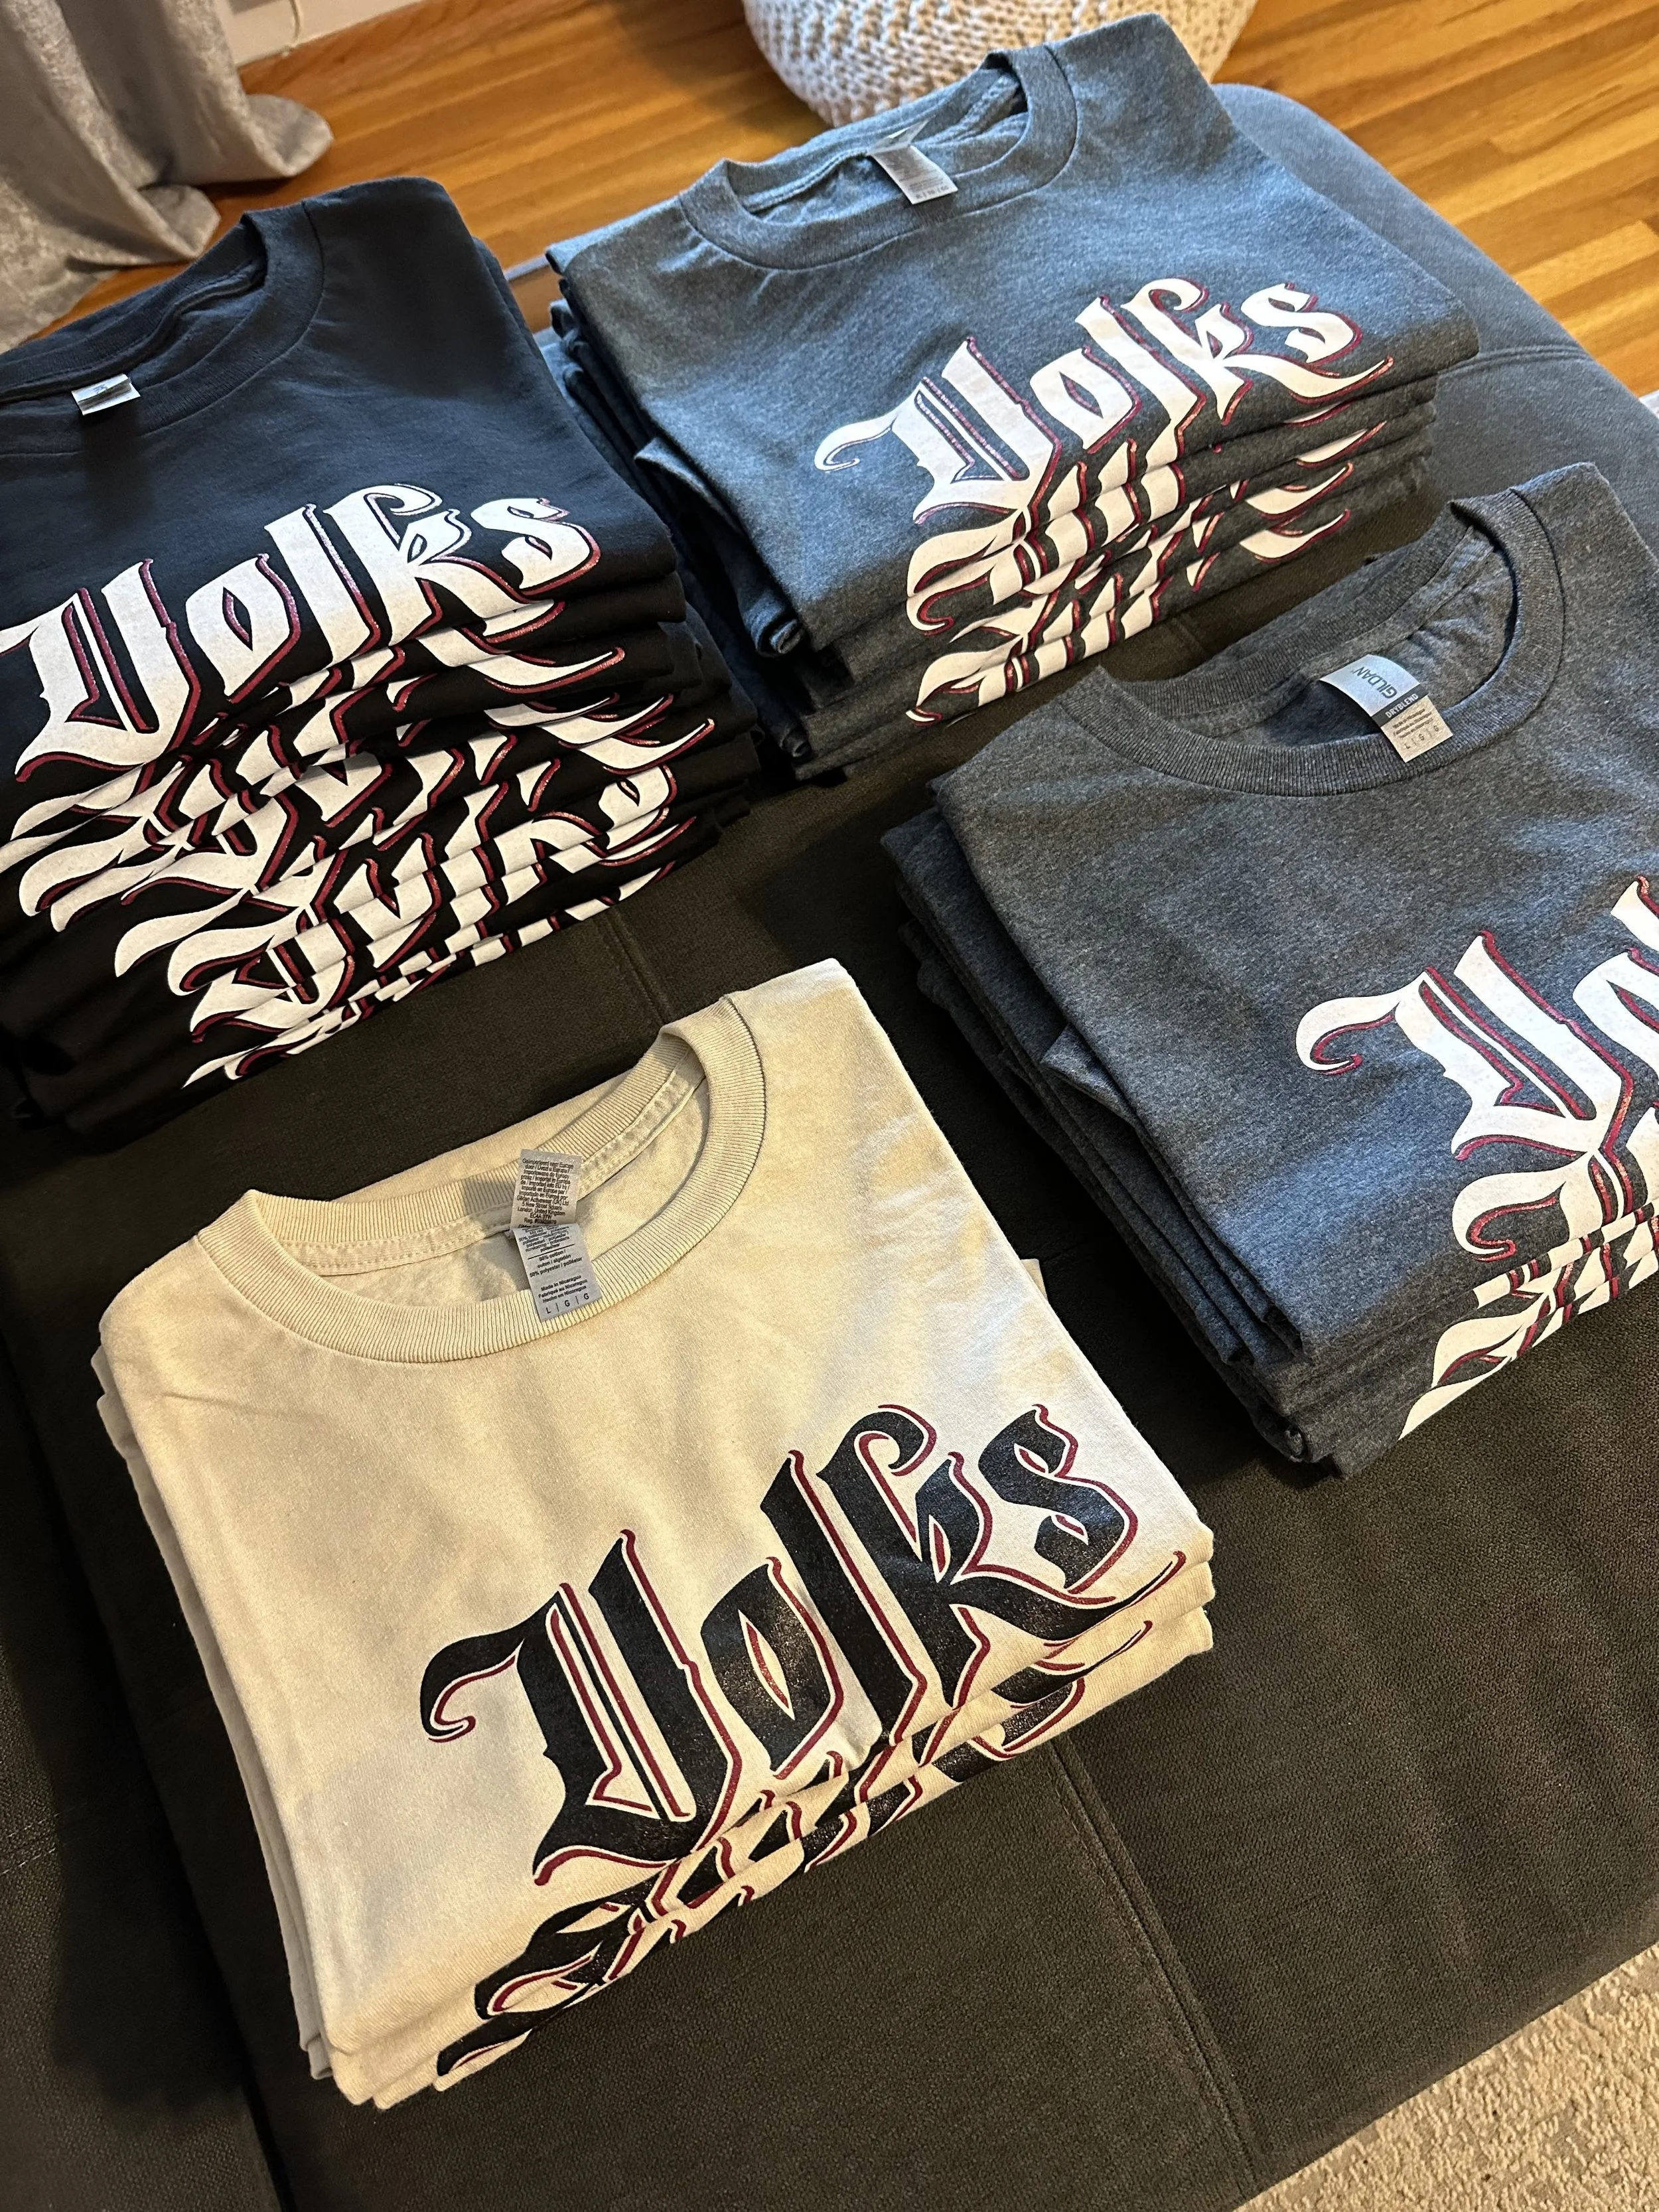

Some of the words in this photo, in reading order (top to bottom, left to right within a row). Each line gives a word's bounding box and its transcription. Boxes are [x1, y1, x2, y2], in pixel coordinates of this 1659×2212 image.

[815, 278, 1394, 524] Volks
[0, 484, 600, 782] Volks
[1352, 666, 1398, 699] GILDAN
[1385, 693, 1419, 718] DRYBLEND
[559, 1276, 581, 1285] Nicaragua
[564, 1286, 587, 1295] Nicaragua
[565, 1280, 587, 1289] Nicaragua
[421, 1404, 1187, 1886] Volks
